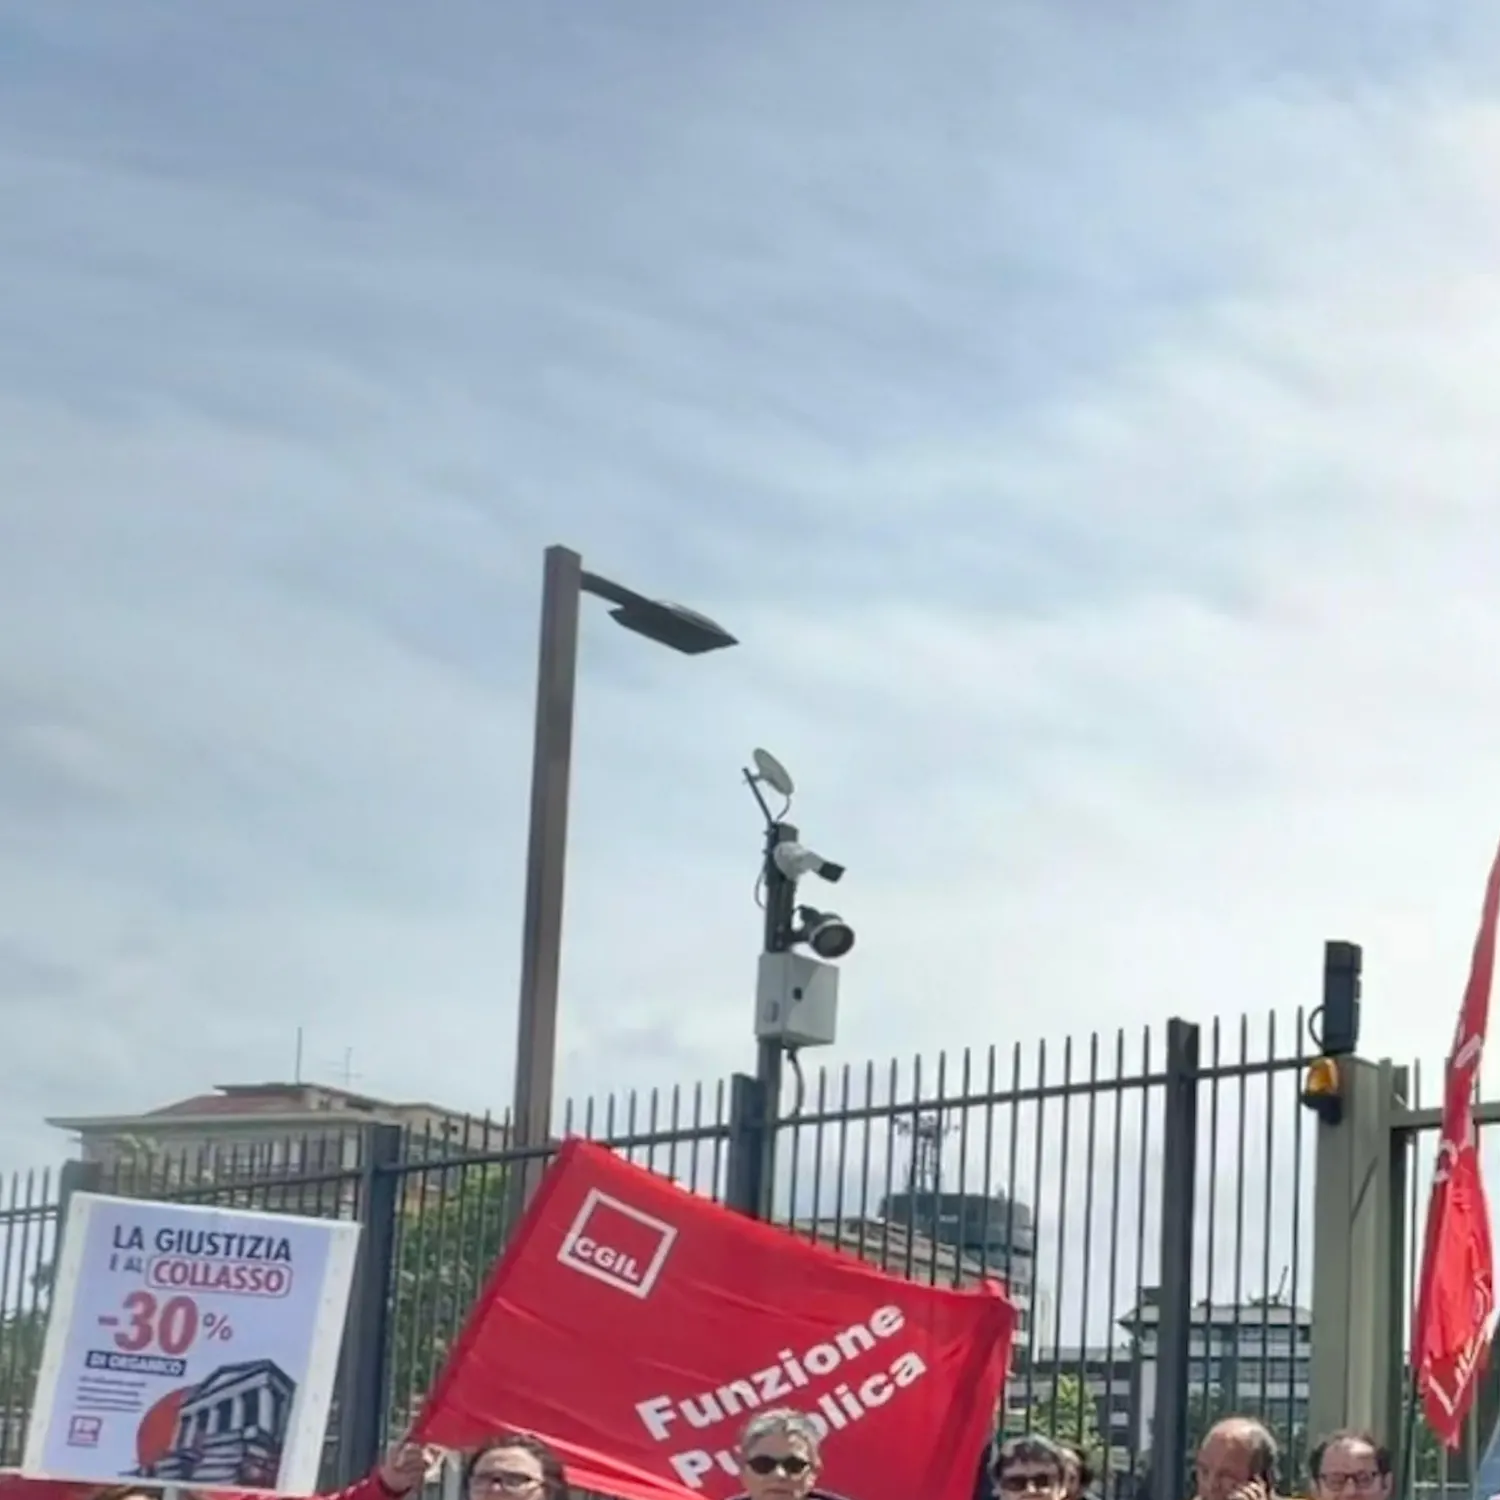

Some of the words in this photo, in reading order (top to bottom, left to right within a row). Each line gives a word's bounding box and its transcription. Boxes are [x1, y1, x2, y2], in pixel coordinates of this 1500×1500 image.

[113, 1225, 144, 1250] LA
[155, 1228, 292, 1262] GIUSTIZIA
[574, 1236, 640, 1281] CGIL
[153, 1260, 285, 1293] COLLASSO
[634, 1304, 905, 1441] Funzione
